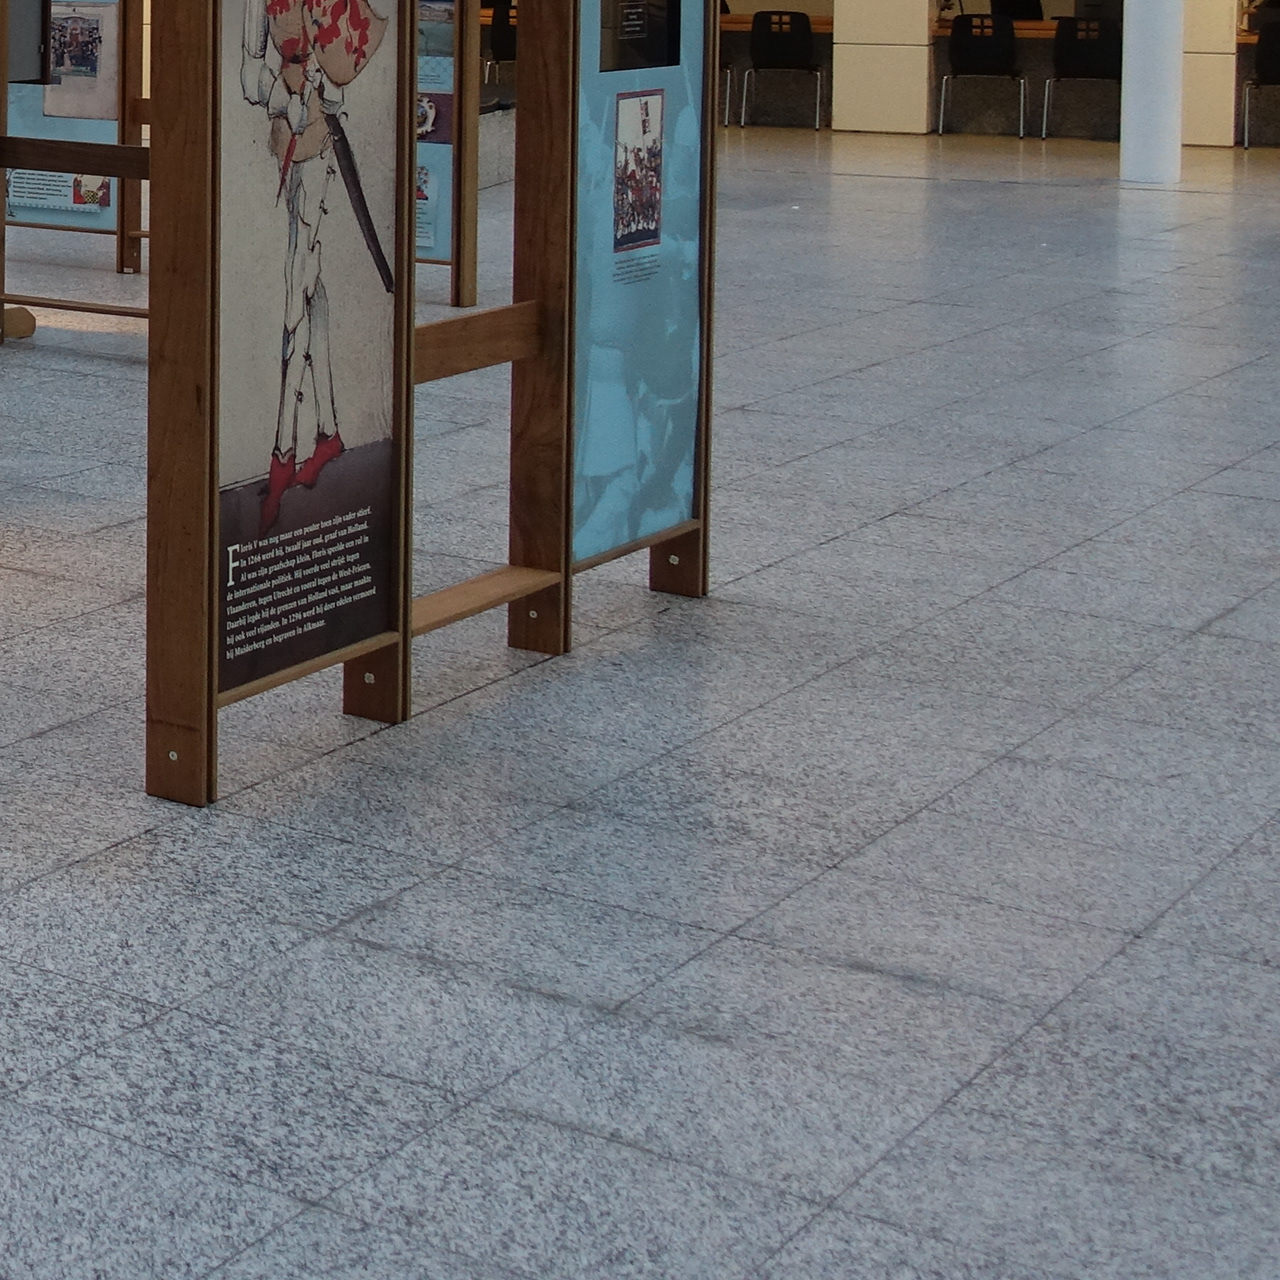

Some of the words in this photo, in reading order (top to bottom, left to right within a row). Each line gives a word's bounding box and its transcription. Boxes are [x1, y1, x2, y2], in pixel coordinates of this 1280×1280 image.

[248, 554, 261, 565] 1266
[262, 549, 274, 560] werd
[285, 541, 301, 553] twaalf
[302, 540, 311, 550] jaar
[325, 530, 337, 543] graaf
[254, 540, 258, 549] V
[259, 539, 268, 547] was
[280, 532, 293, 540] maar
[343, 512, 356, 521] vader
[227, 592, 233, 601] de
[321, 560, 330, 570] veel
[347, 552, 359, 562] tegen
[241, 572, 246, 582] Al
[312, 548, 326, 559] Floris
[227, 616, 246, 630] Daarbij
[270, 607, 276, 615] de
[277, 601, 297, 615] grenzen
[308, 588, 327, 602] Holland
[341, 583, 352, 592] maar
[354, 576, 371, 587] maakte
[259, 595, 272, 605] tegen
[274, 587, 292, 600] Utrecht
[294, 585, 300, 593] en
[301, 579, 316, 590] vooral
[318, 576, 331, 586] tegen
[332, 572, 338, 580] de
[235, 631, 245, 641] ook
[246, 627, 256, 637] veel
[289, 612, 301, 622] 1296
[303, 608, 315, 617] werd
[324, 602, 335, 611] door
[273, 630, 295, 642] begraven
